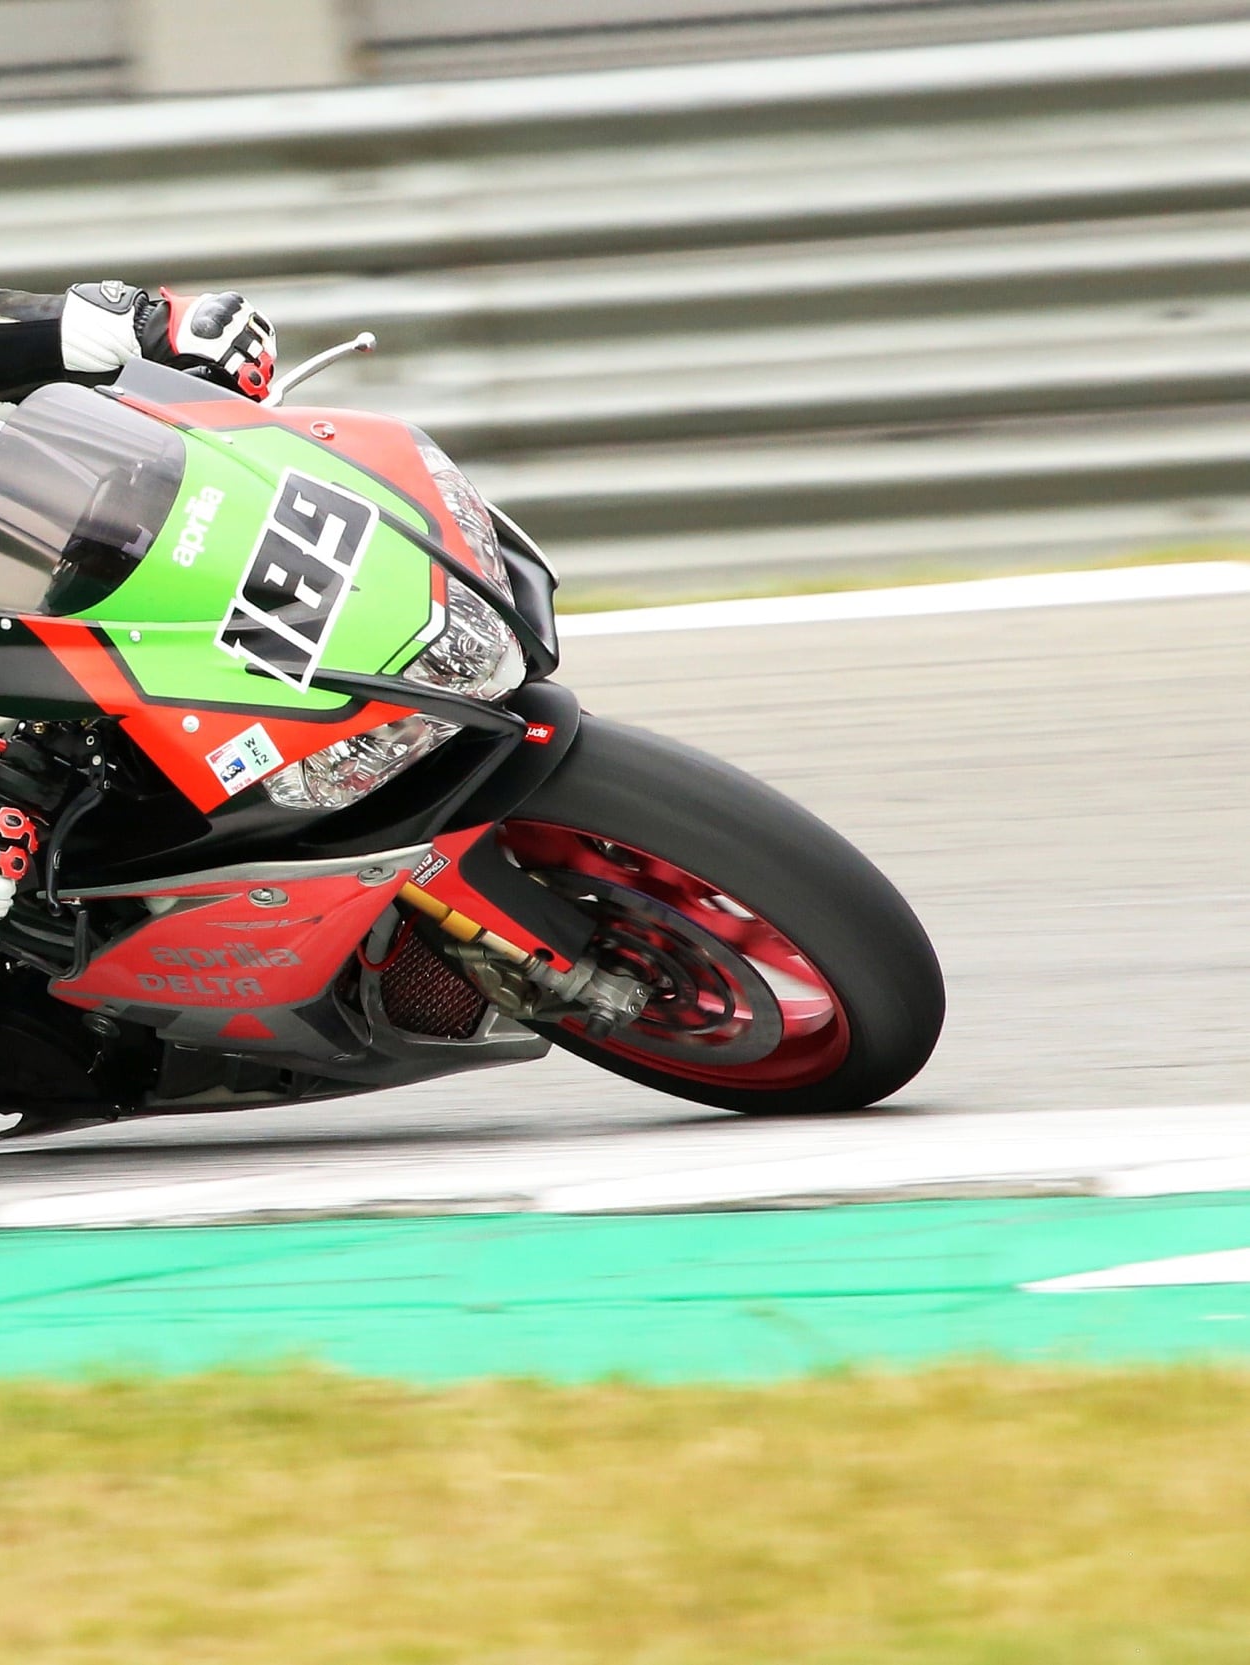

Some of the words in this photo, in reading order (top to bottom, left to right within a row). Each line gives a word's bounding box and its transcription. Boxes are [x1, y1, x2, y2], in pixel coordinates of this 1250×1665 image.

[172, 486, 225, 567] aprilia
[214, 467, 380, 694] 189
[150, 942, 303, 971] aprilia
[136, 973, 265, 996] DELTA
